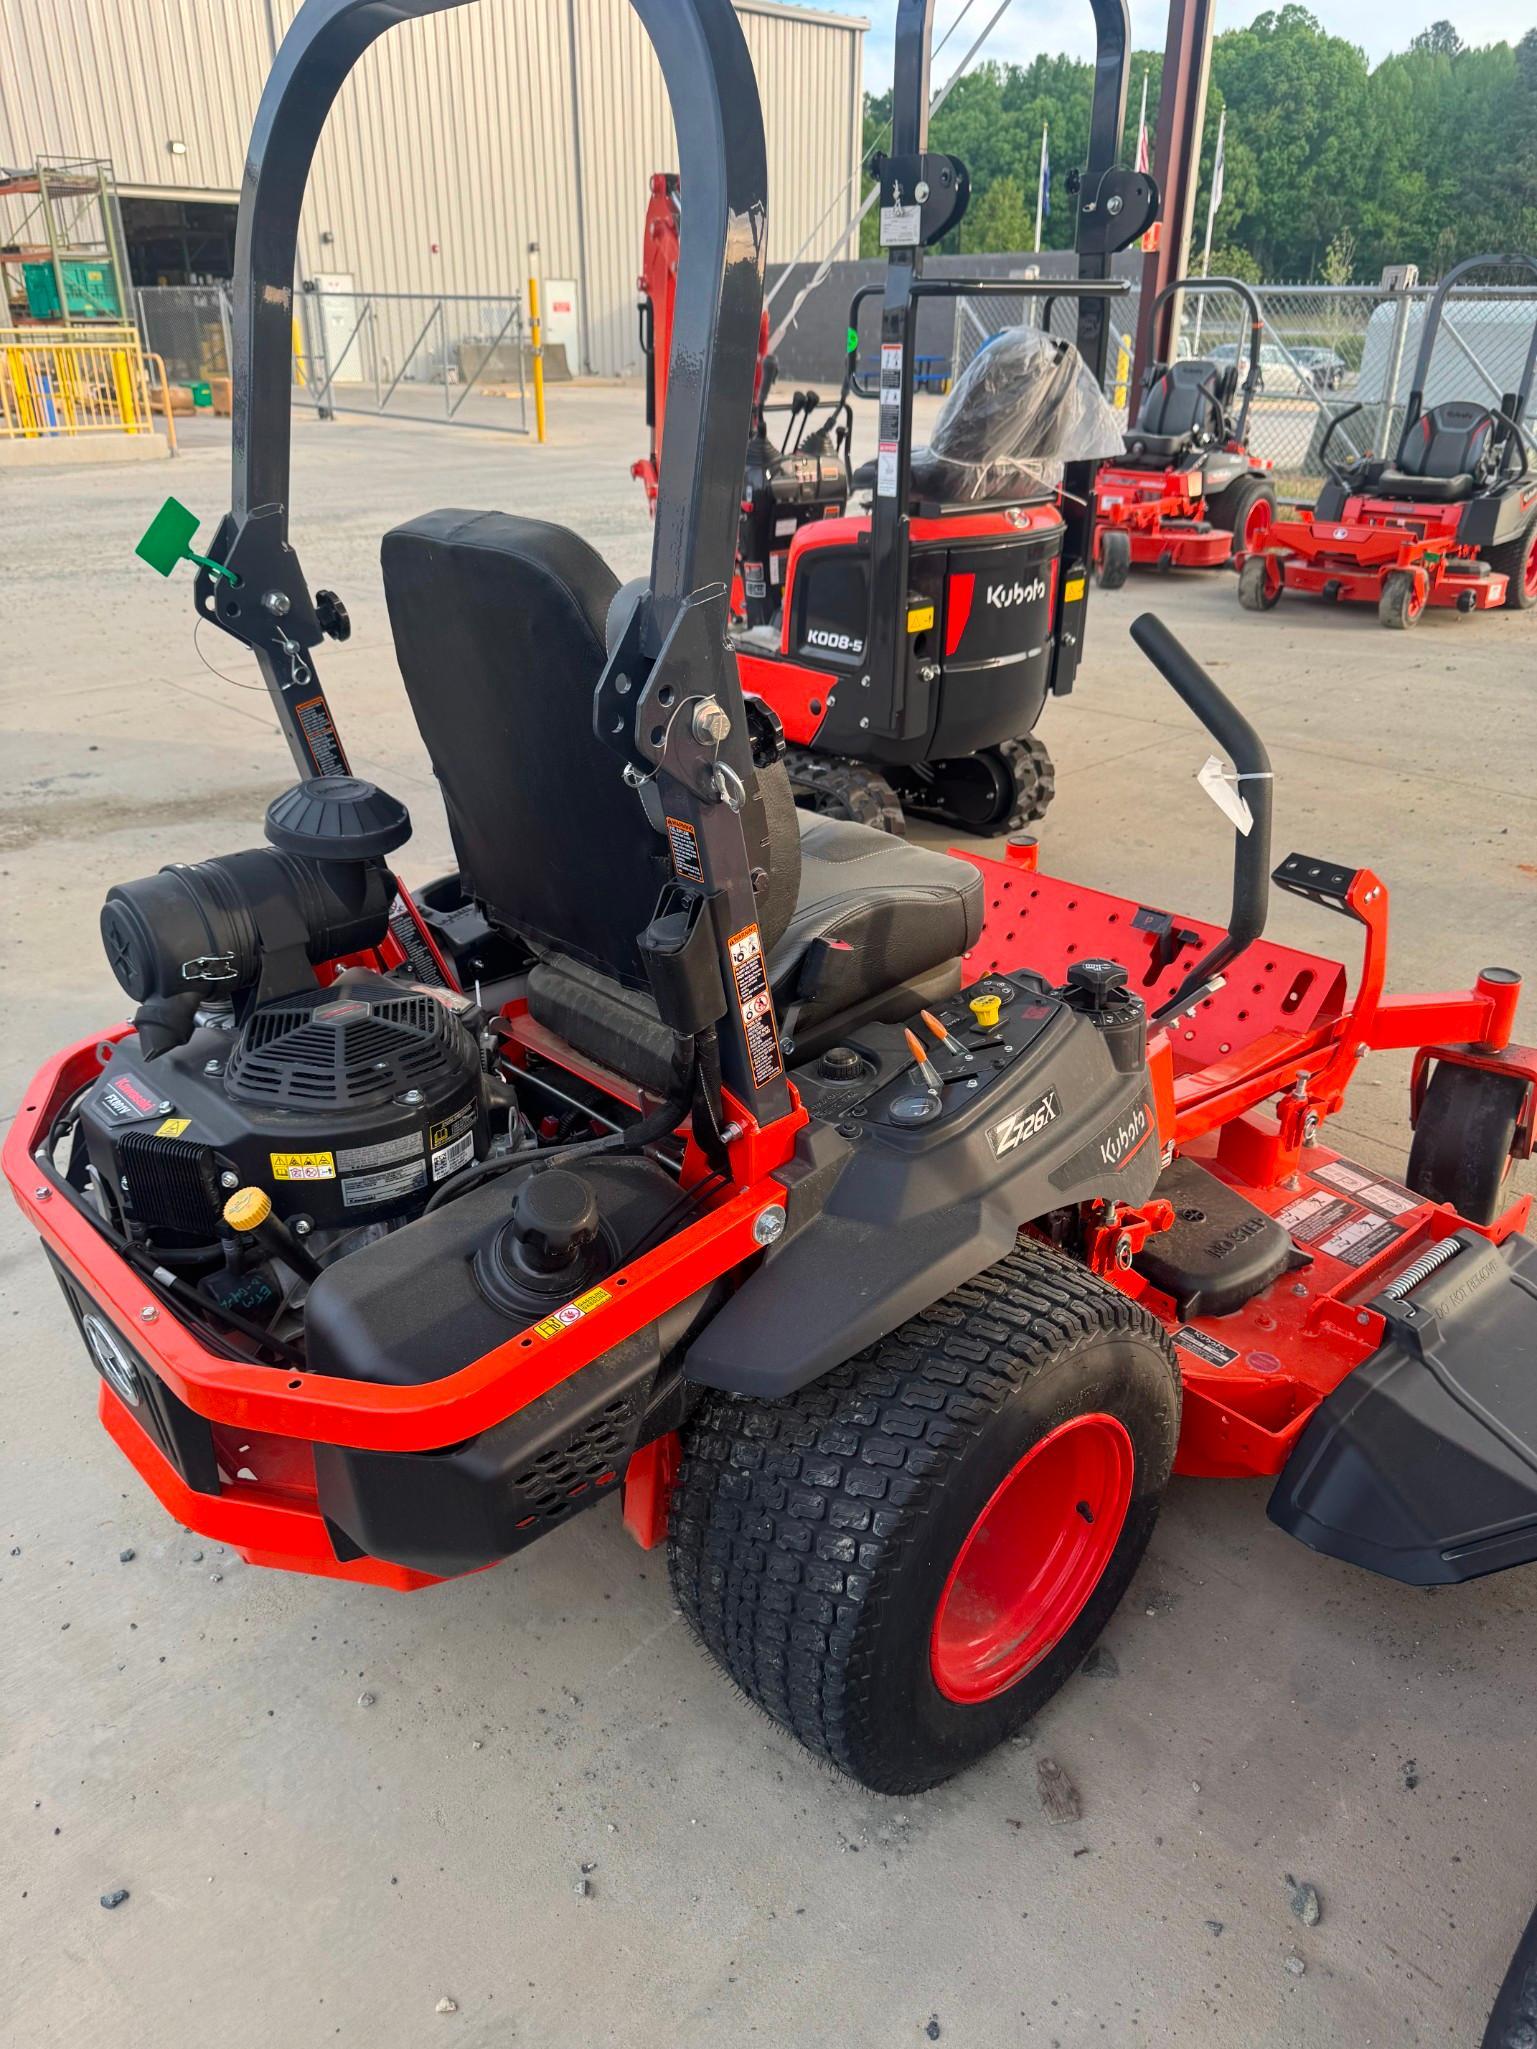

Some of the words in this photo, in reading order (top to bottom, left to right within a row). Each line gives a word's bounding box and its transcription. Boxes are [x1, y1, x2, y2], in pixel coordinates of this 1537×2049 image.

[986, 577, 1045, 608] Kubota
[807, 629, 863, 652] K008-5
[114, 1077, 157, 1112] Kawasaki
[995, 1092, 1057, 1156] Z726X
[1101, 1110, 1145, 1164] Kubota
[1206, 1240, 1236, 1260] NO
[1230, 1217, 1268, 1243] STEP
[1193, 1331, 1225, 1351] Kubota
